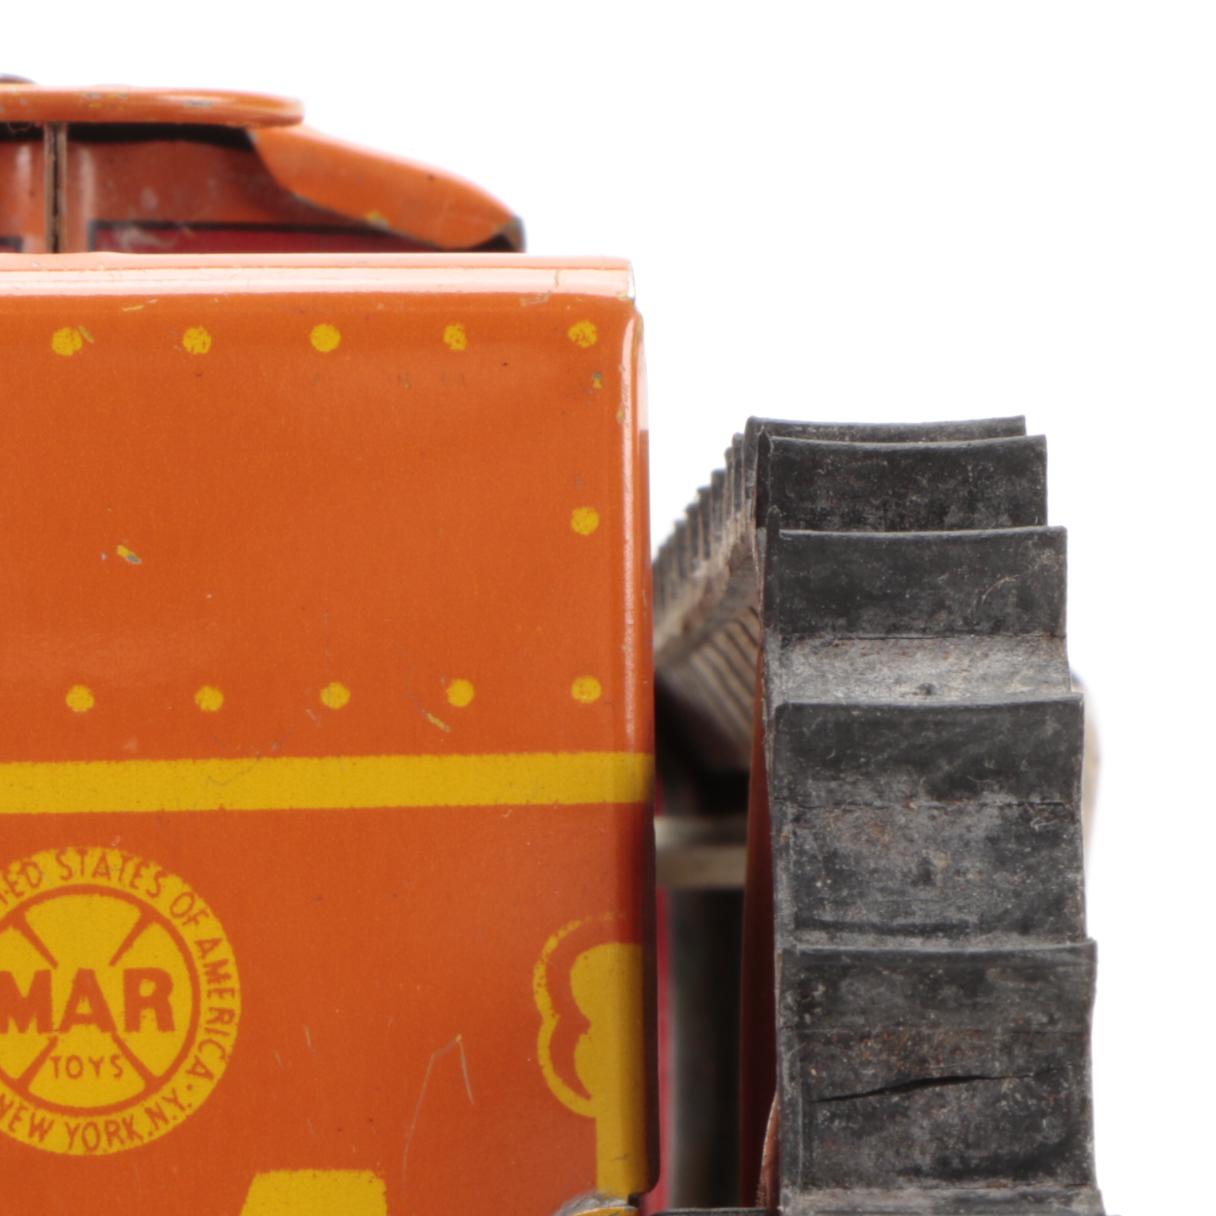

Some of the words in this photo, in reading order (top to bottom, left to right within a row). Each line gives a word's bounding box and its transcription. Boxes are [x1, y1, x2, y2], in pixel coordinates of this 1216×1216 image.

[55, 849, 166, 899] STATES
[169, 891, 209, 927] OF
[185, 937, 235, 1082] AMERICA
[50, 1054, 124, 1079] TOYS
